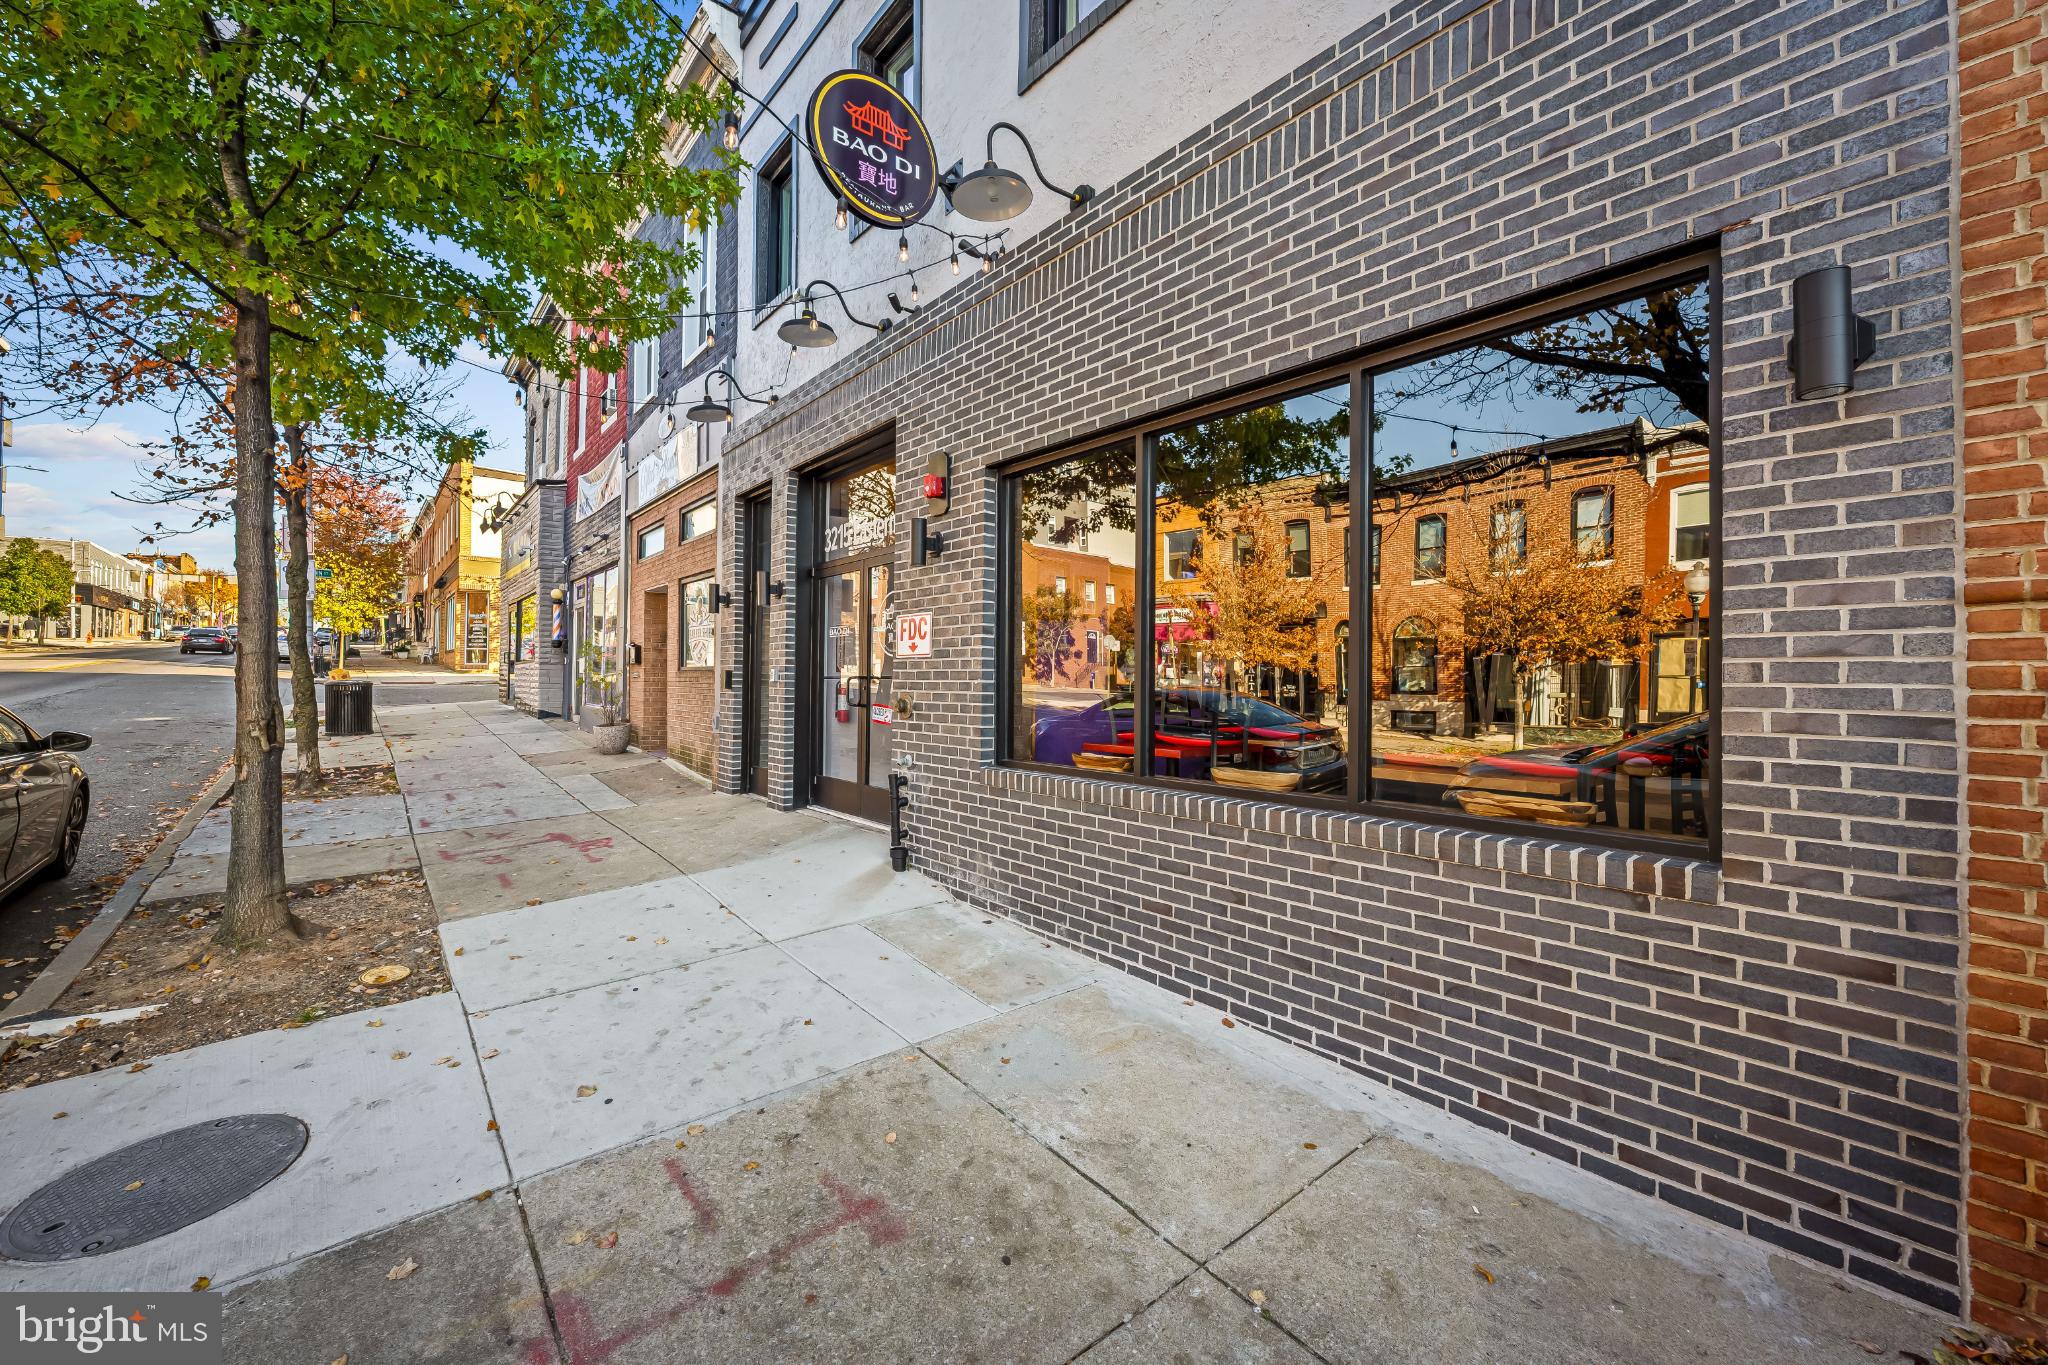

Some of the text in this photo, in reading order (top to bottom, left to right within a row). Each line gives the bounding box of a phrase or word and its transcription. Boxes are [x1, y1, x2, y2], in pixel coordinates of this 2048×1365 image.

[832, 126, 921, 180] BAO DI
[858, 160, 898, 195] 寶地
[899, 202, 914, 213] BAR
[824, 521, 853, 553] 3215
[900, 617, 928, 641] FDC
